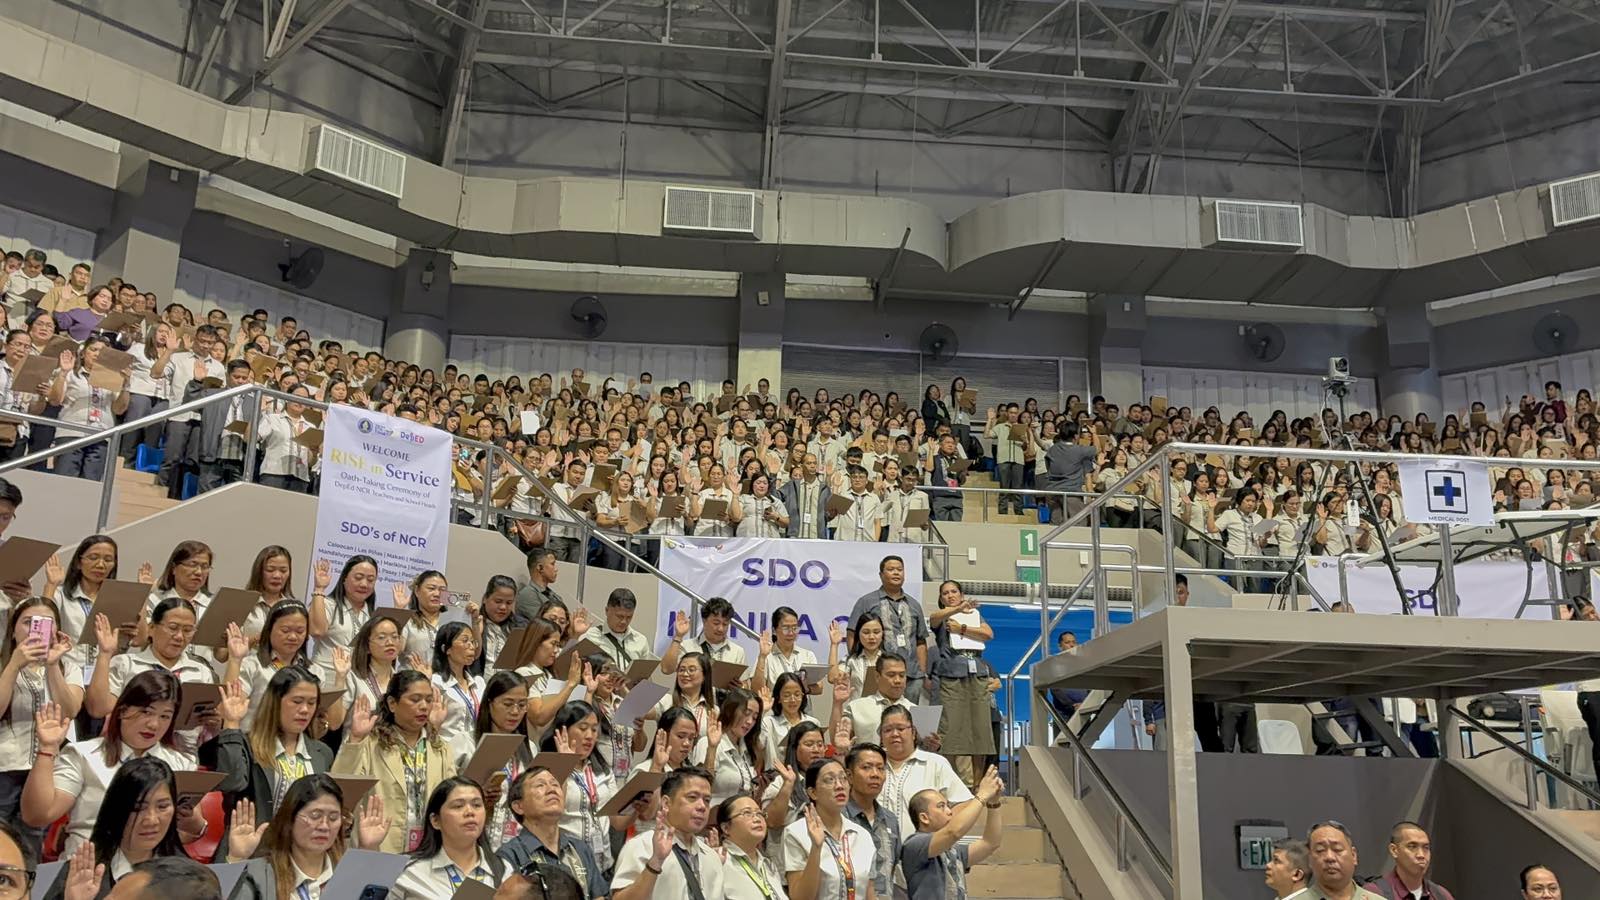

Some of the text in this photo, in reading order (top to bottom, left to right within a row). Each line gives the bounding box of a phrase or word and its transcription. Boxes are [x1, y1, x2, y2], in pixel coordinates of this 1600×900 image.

[362, 442, 411, 461] WELCOME
[330, 447, 366, 469] RISE
[385, 463, 440, 487] Service
[340, 471, 430, 499] Oath-Taking Ceremony of
[340, 521, 427, 549] SDO's of NCR
[1024, 533, 1034, 552] 1
[386, 552, 405, 561] Makati
[741, 557, 831, 589] SDO
[1402, 588, 1461, 609] SD
[1250, 840, 1273, 866] EXI
